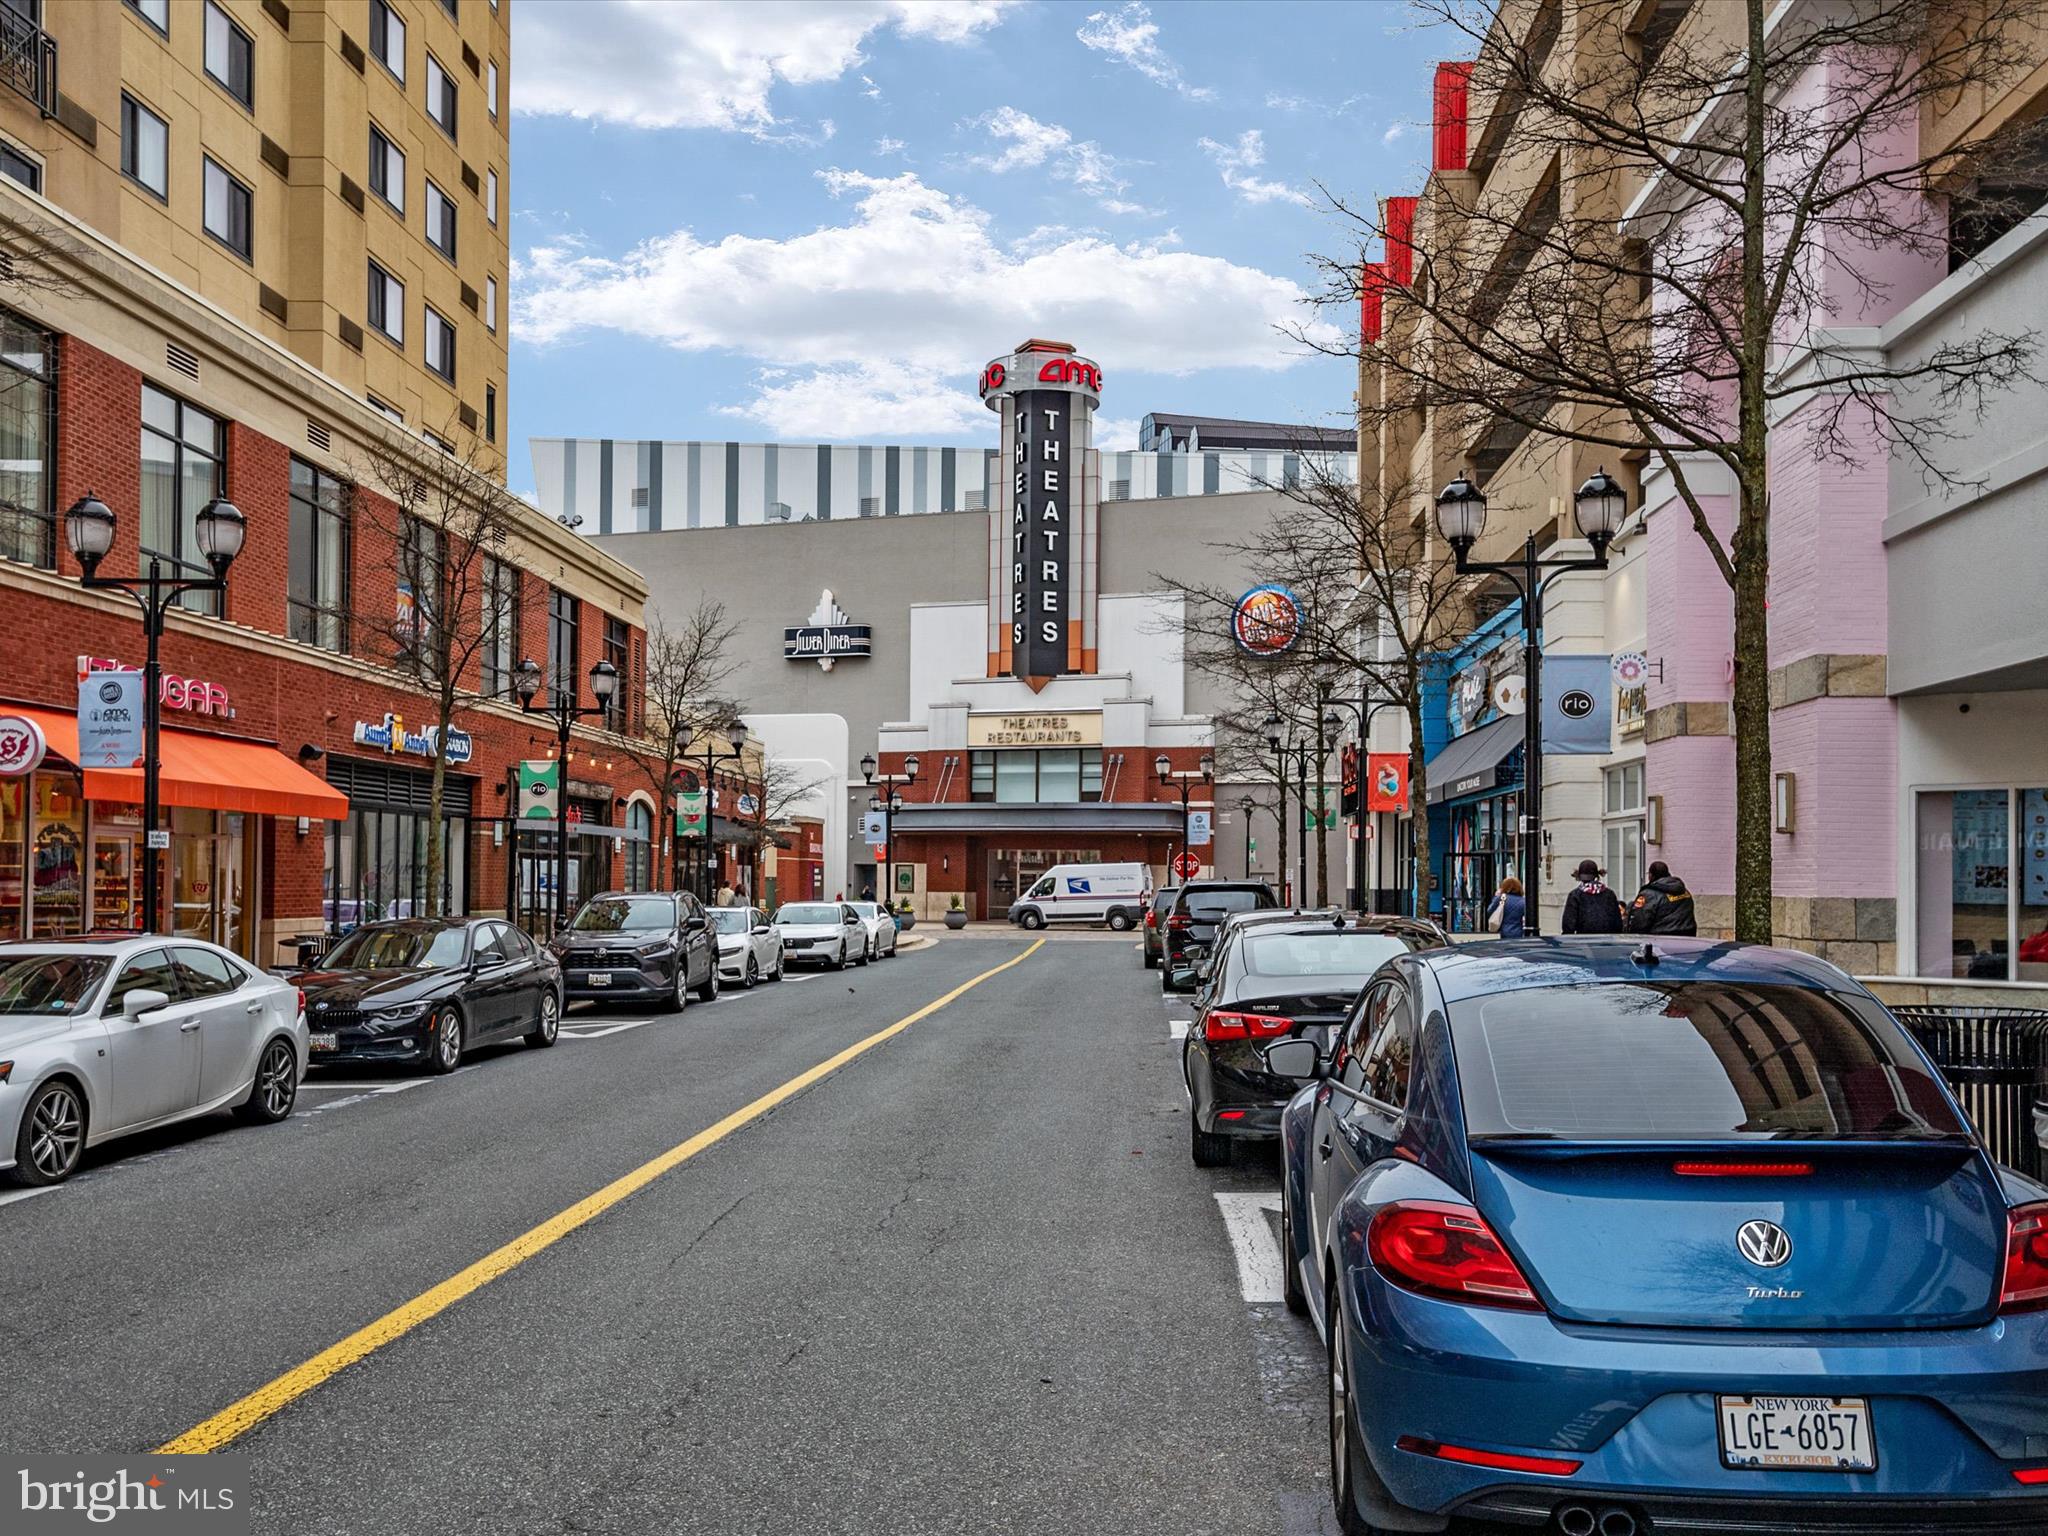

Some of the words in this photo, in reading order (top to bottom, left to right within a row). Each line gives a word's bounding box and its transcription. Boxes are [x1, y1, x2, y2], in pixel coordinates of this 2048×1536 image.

[1039, 359, 1103, 392] amc
[1014, 412, 1025, 644] THEATRES
[1042, 409, 1060, 643] THEATRES
[1564, 697, 1590, 710] rio
[1001, 717, 1069, 730] THEATRES
[987, 730, 1082, 744] RESTAURANTS
[532, 784, 548, 793] rio
[1746, 1286, 1804, 1298] Turbo
[1754, 1398, 1792, 1411] NEW
[1793, 1398, 1832, 1412] YORK
[1763, 1454, 1834, 1465] EXCELSIOR
